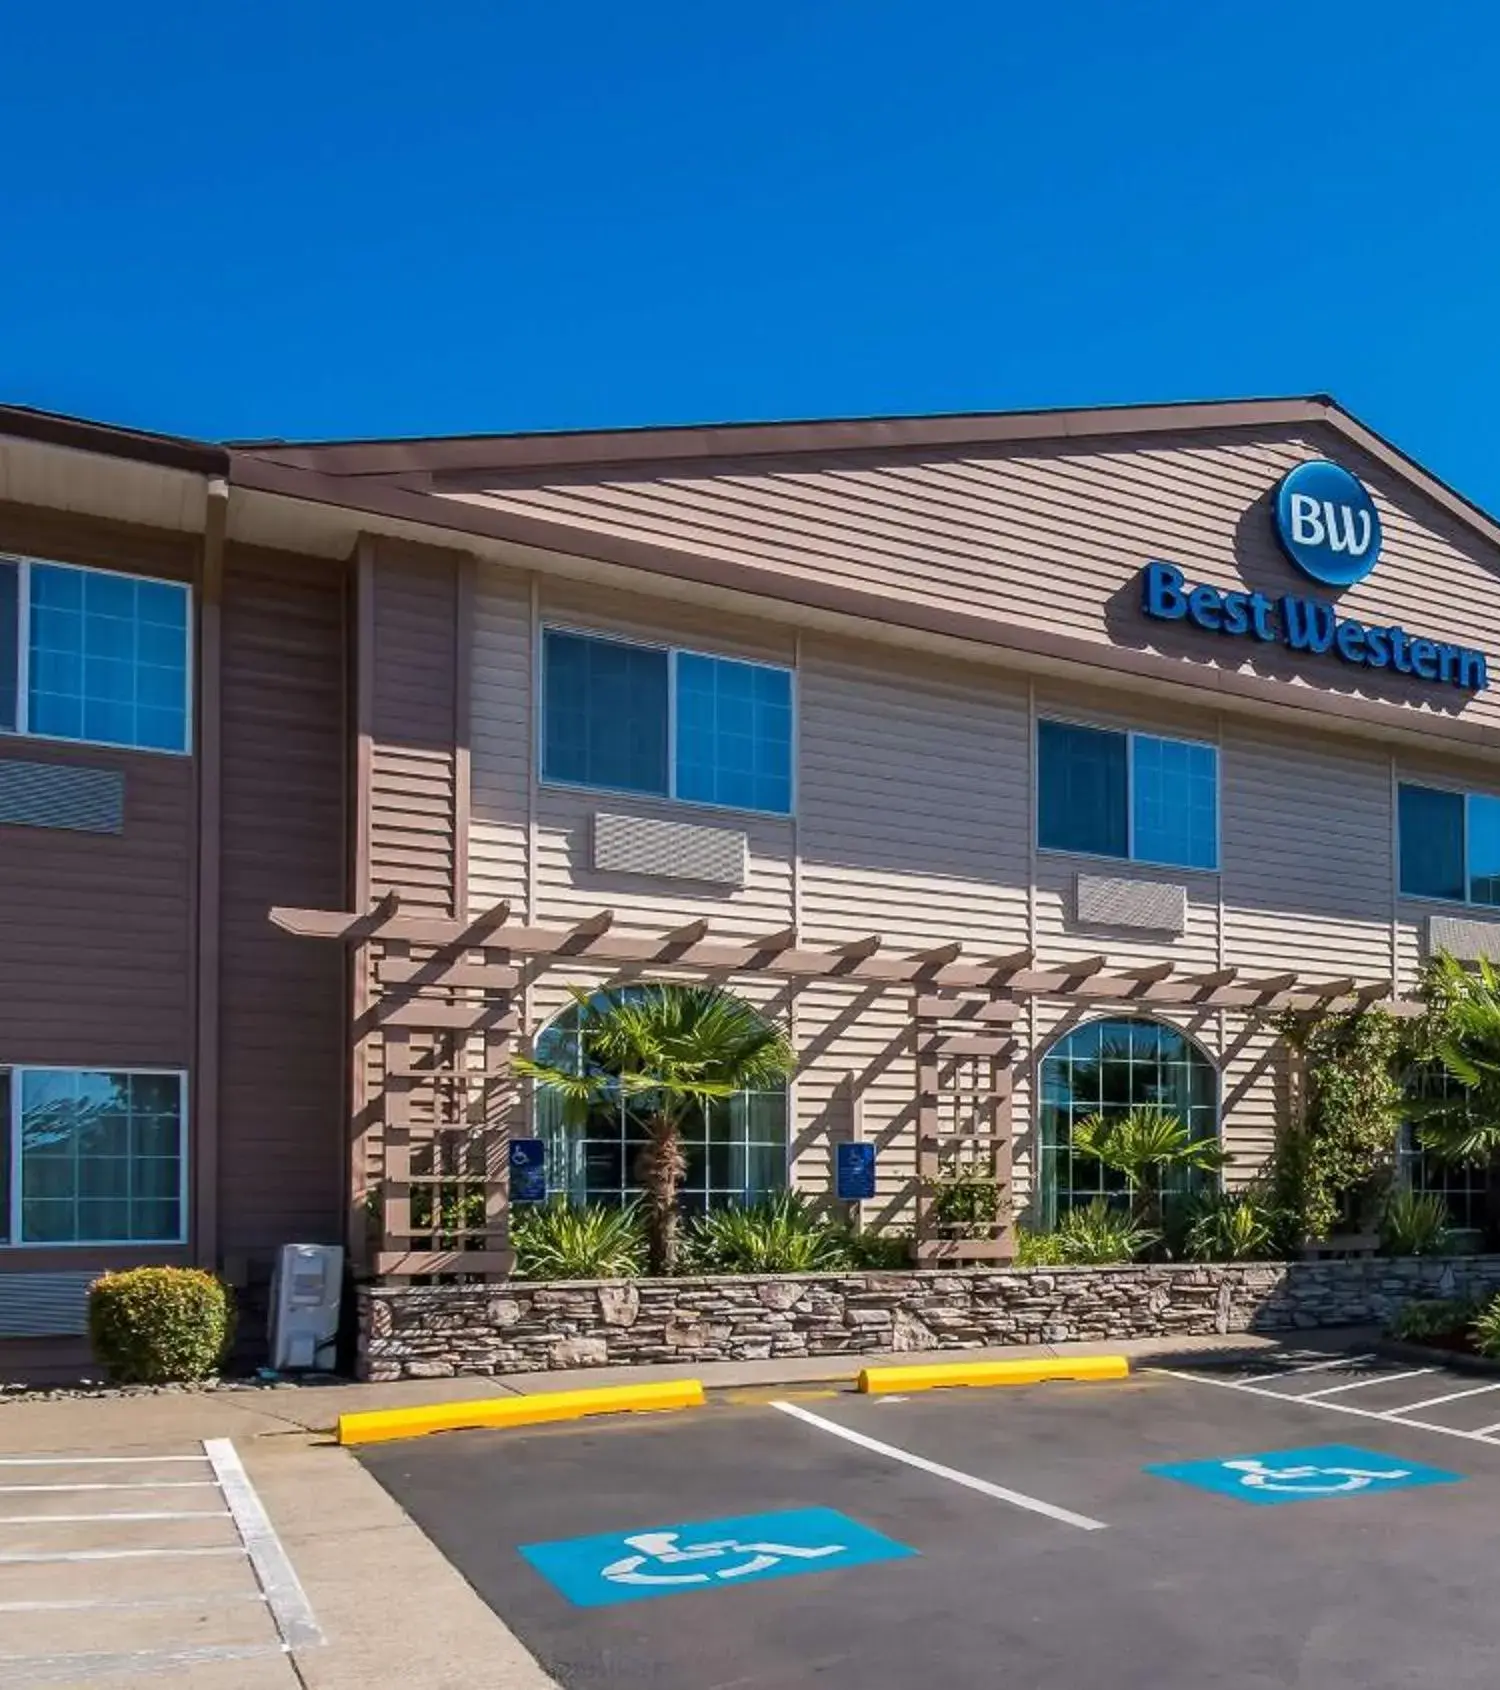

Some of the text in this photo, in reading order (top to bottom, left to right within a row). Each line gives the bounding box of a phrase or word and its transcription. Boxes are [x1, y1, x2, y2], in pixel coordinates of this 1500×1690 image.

[1291, 493, 1371, 556] BW
[1143, 561, 1488, 690] Best Western
